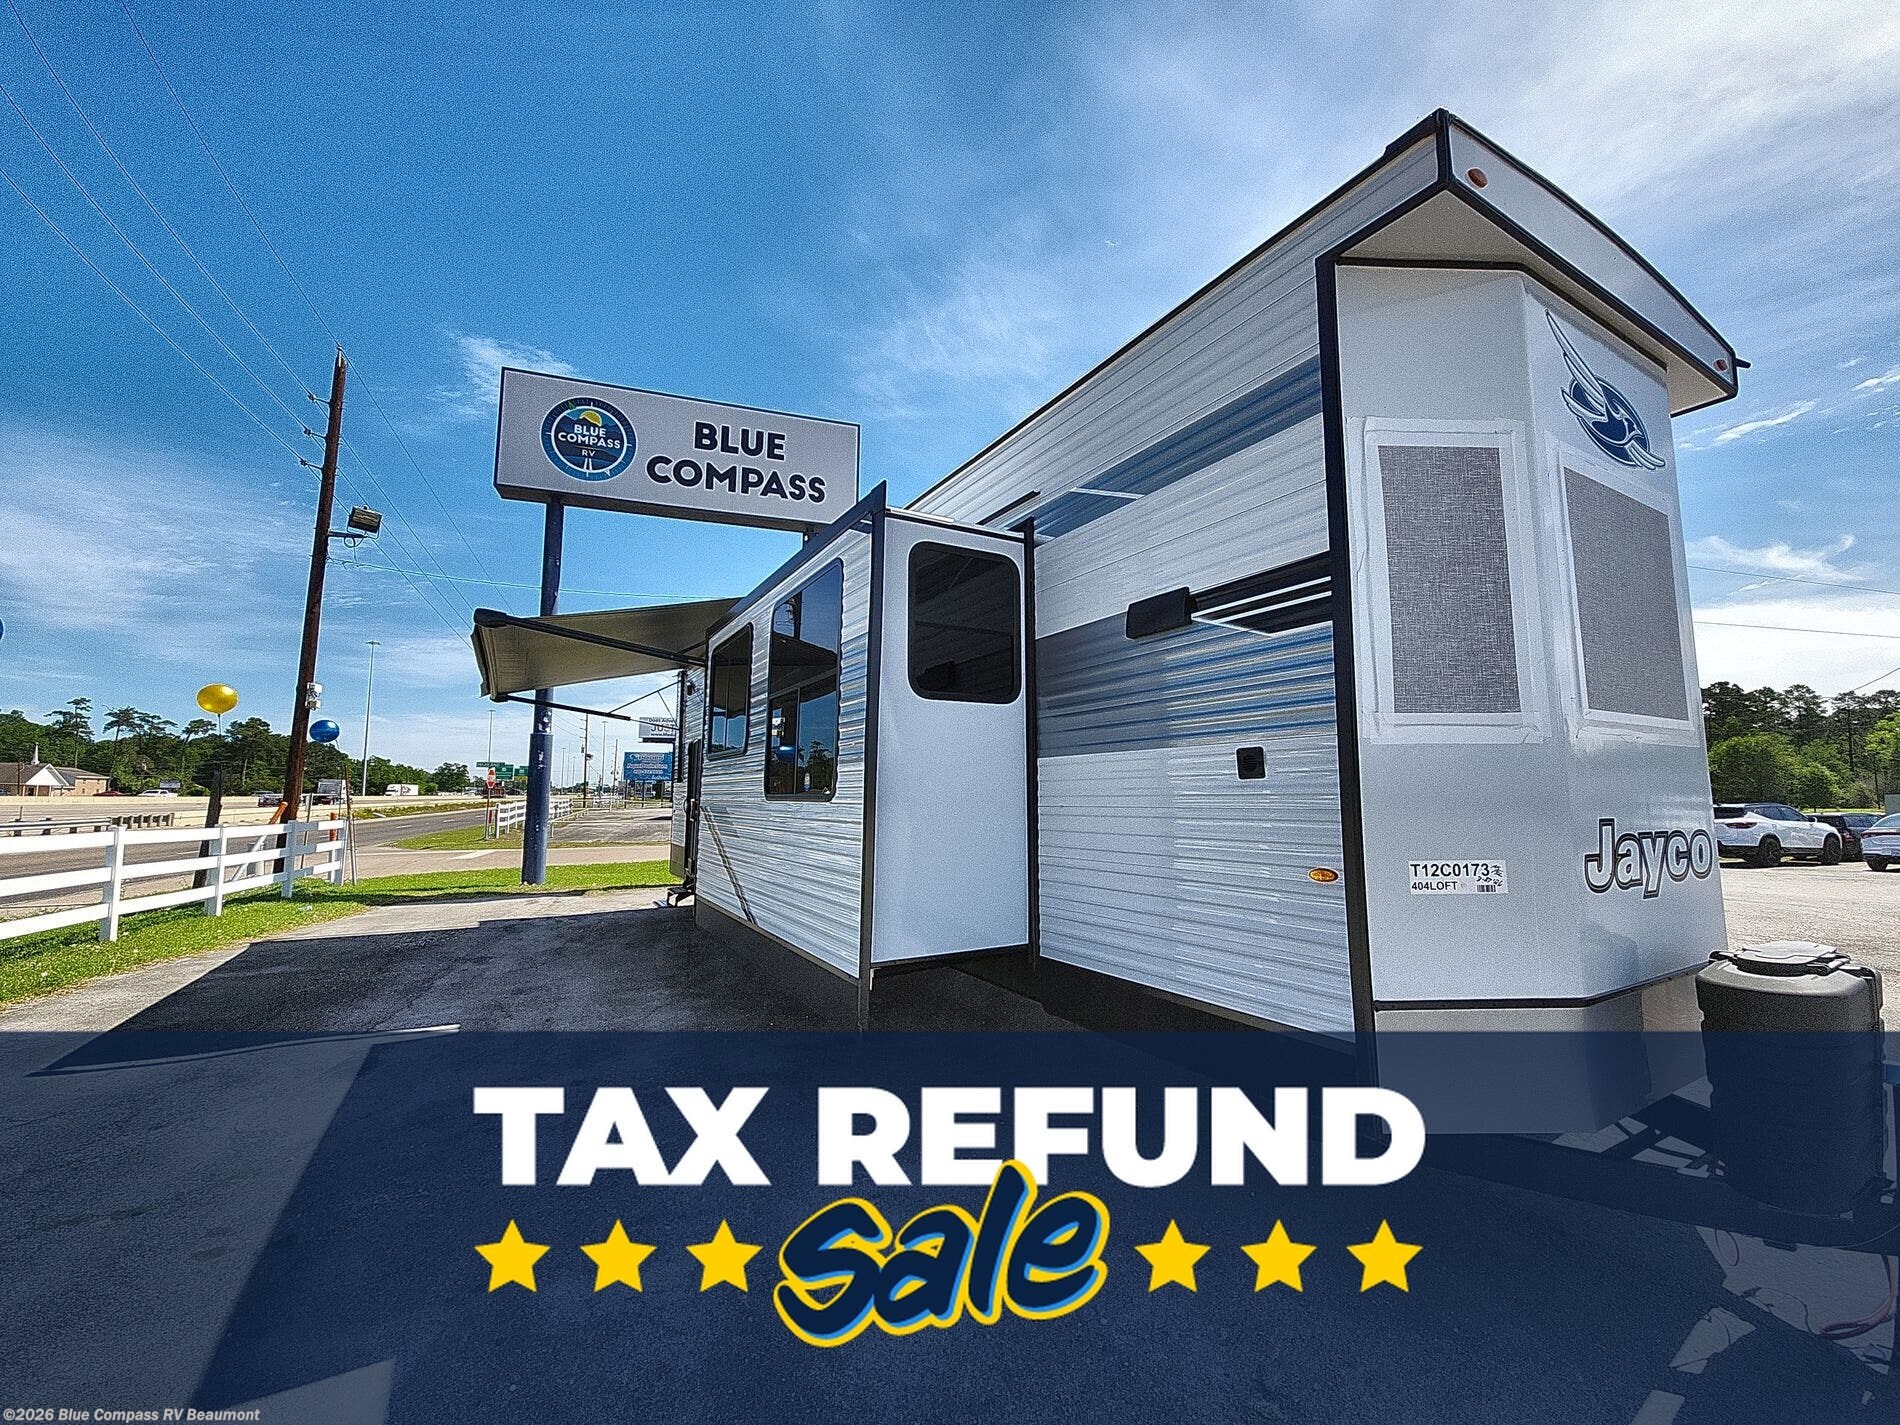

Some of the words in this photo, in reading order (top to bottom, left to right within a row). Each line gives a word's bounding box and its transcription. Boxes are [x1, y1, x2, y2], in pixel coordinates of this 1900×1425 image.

[573, 424, 606, 437] BLUE
[558, 432, 621, 449] COMPASS
[694, 421, 786, 461] BLUE
[581, 449, 596, 457] RV
[646, 455, 826, 503] COMPASS
[1585, 818, 1713, 900] Jayco
[1410, 863, 1489, 877] T12C0173
[1411, 881, 1458, 890] 404LOFT
